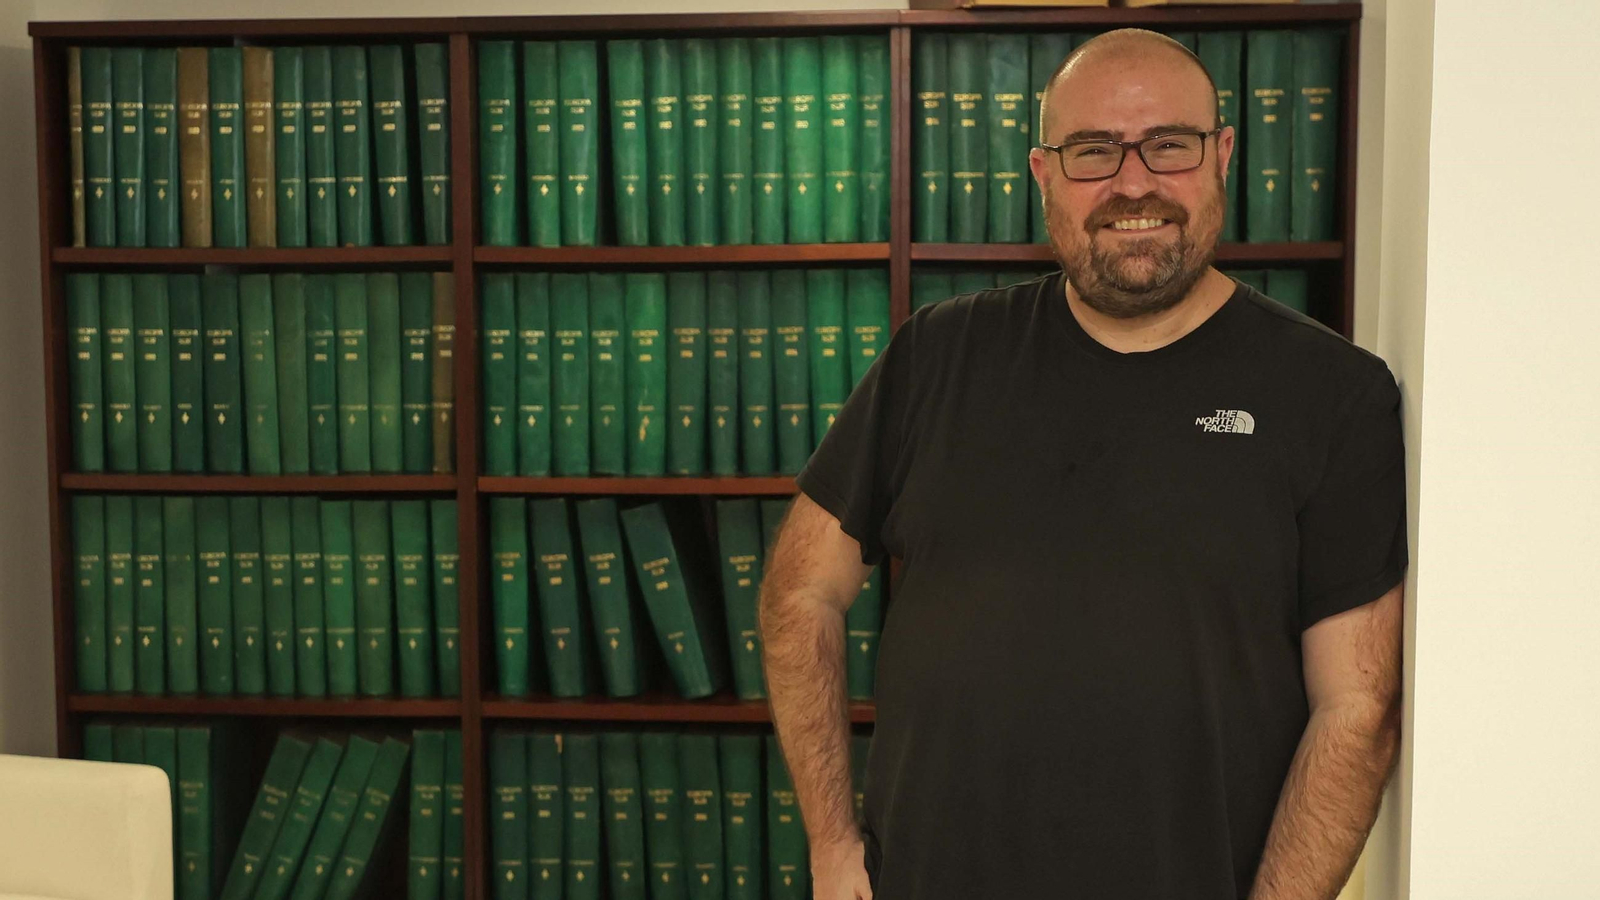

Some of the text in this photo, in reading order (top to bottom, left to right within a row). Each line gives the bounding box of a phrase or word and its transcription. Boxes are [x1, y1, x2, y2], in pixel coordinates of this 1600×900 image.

[1215, 409, 1238, 418] THE
[1195, 416, 1235, 426] NORTH
[1203, 424, 1232, 433] FACE
